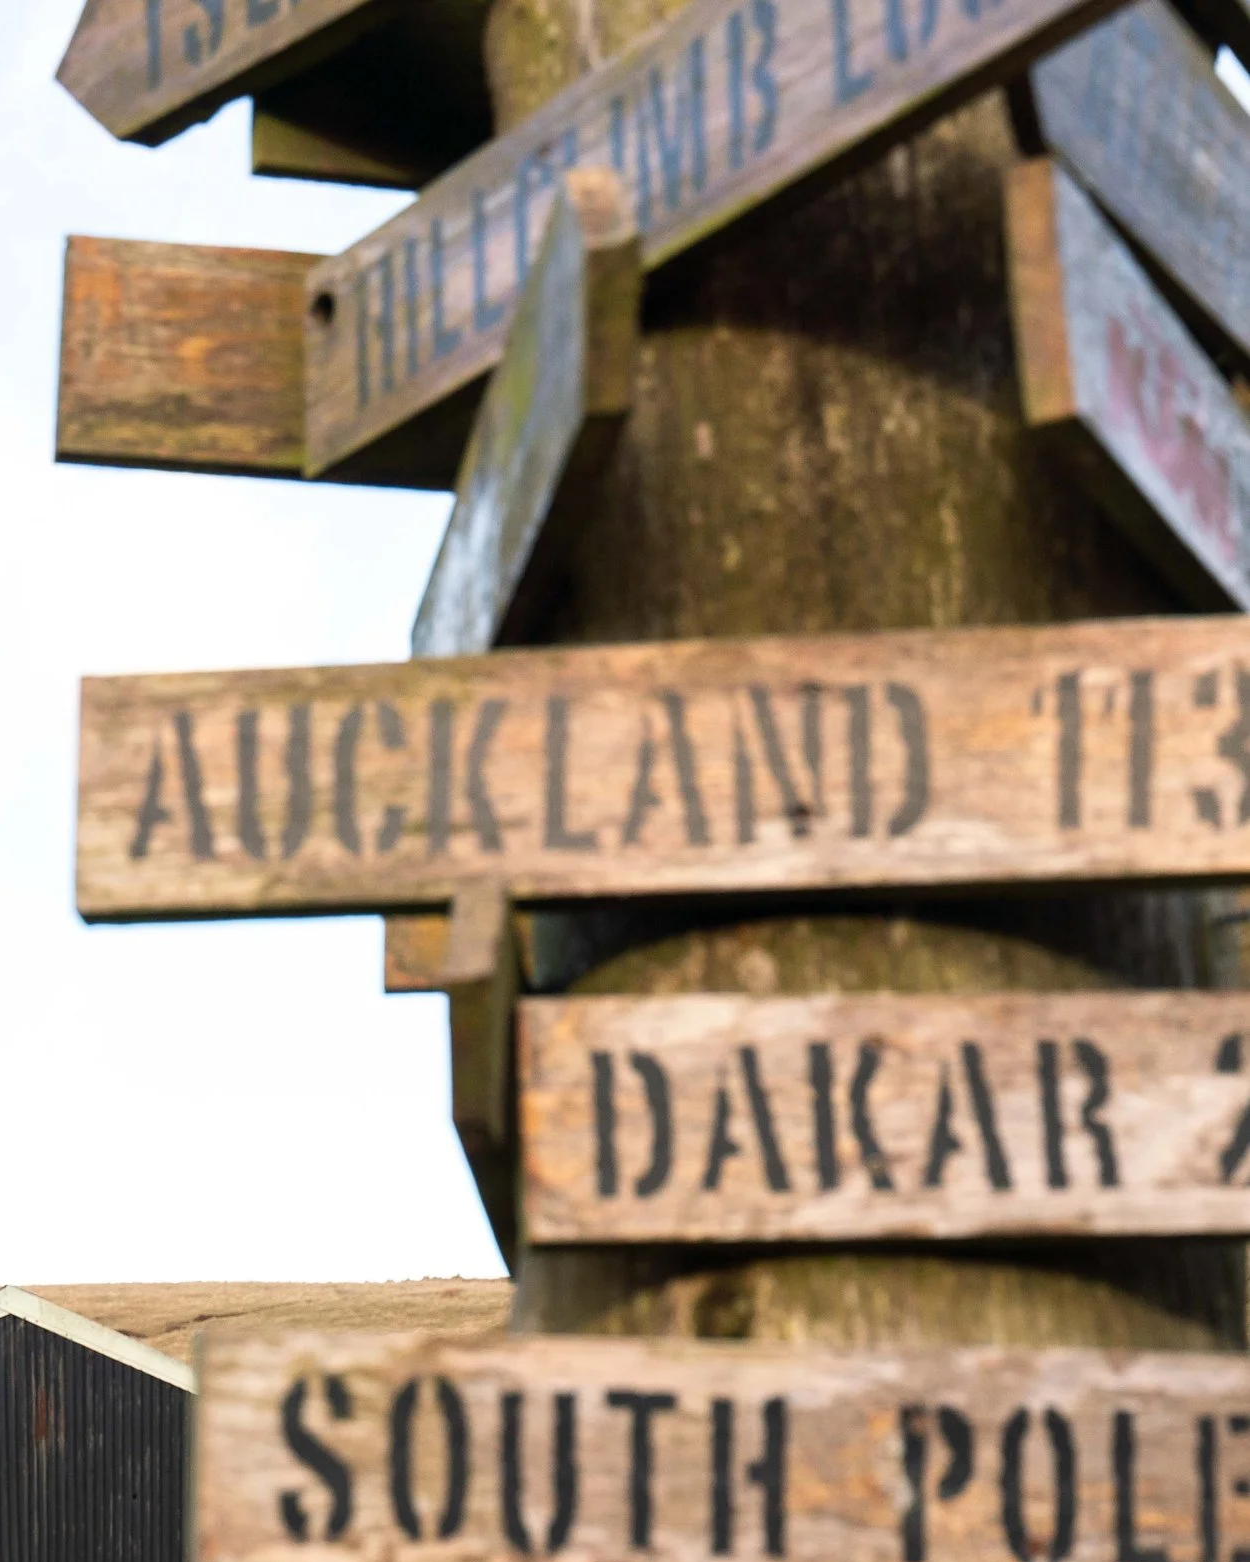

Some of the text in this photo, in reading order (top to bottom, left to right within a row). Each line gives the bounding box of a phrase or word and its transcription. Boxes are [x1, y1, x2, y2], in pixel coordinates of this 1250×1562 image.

[129, 680, 931, 863] AUCKLAND
[590, 1036, 1119, 1198] DAKAR
[277, 1374, 786, 1556] SOUTH
